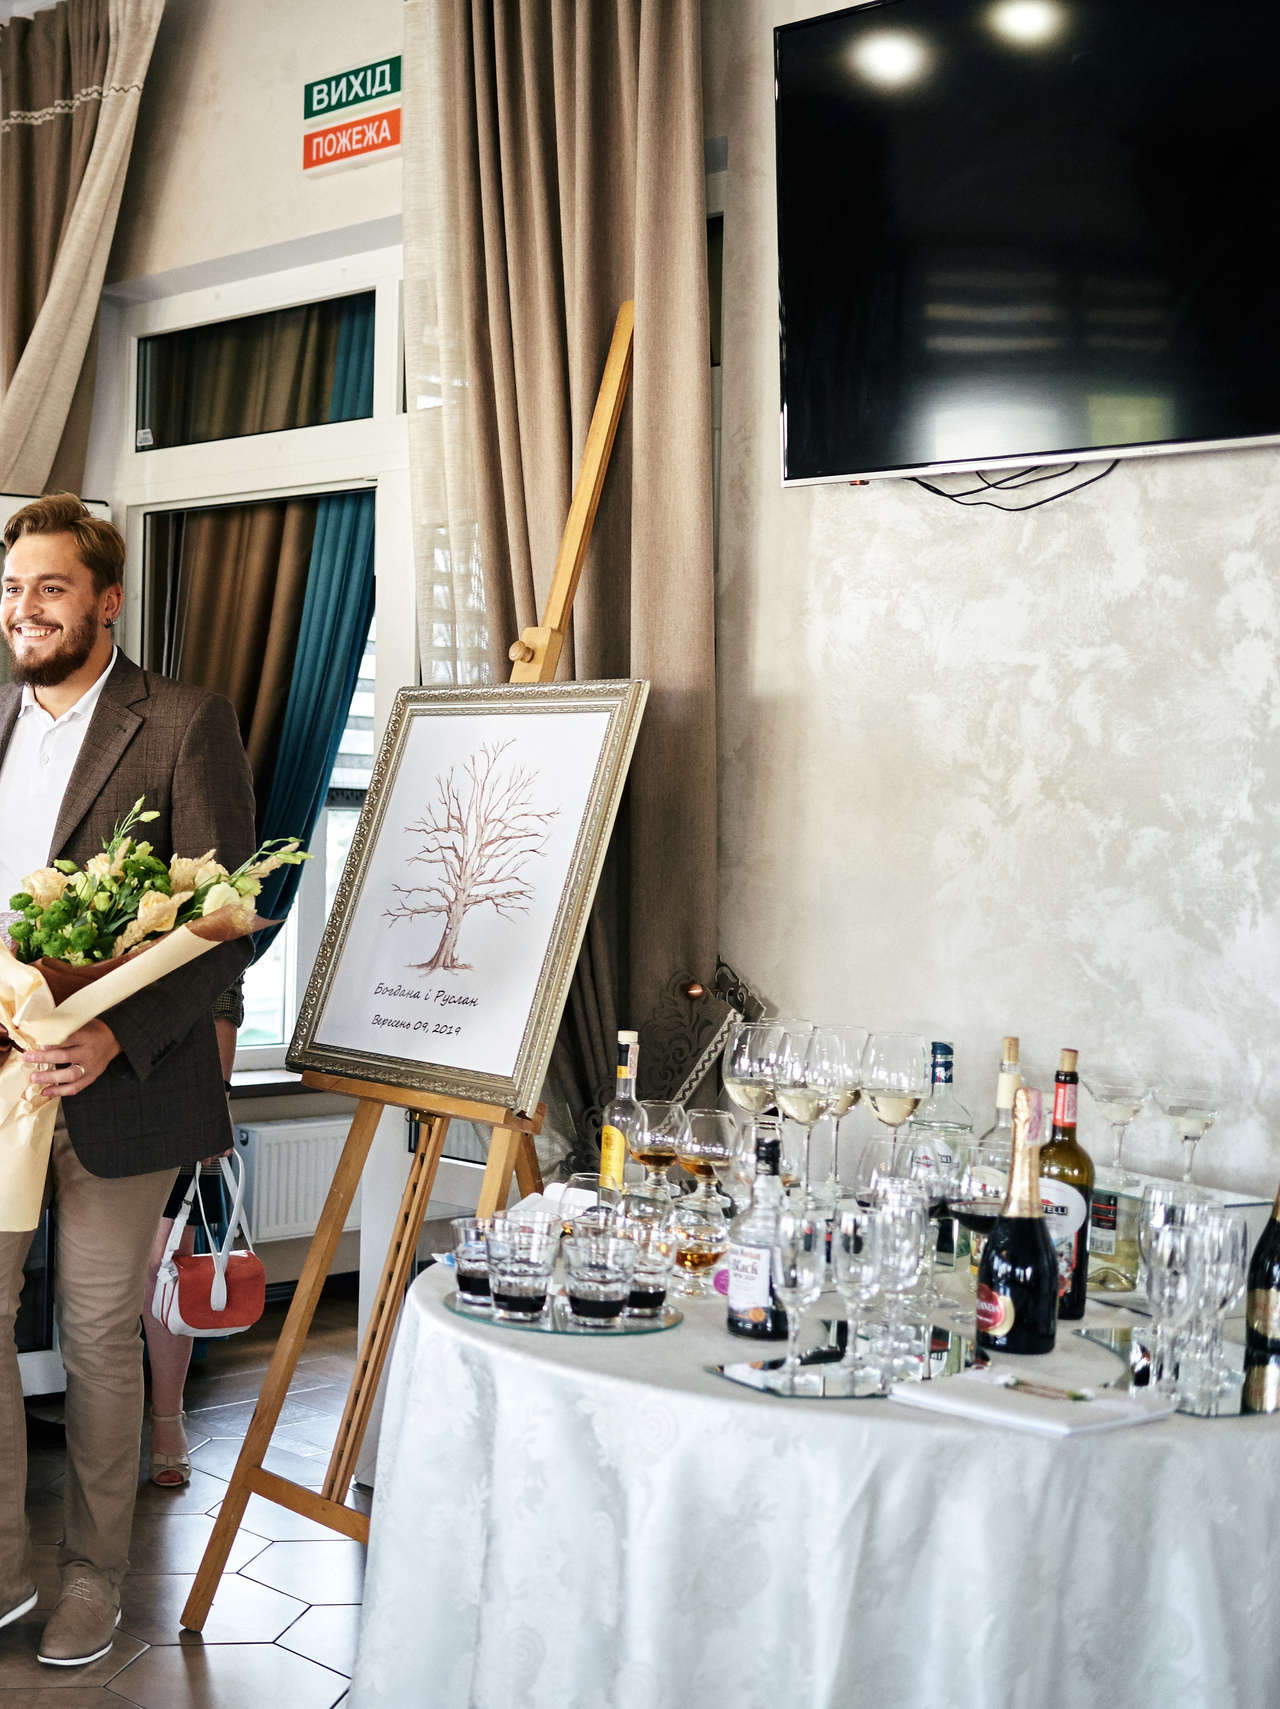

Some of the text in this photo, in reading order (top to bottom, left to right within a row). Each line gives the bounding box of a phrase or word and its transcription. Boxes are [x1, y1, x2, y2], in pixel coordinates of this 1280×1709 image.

[312, 63, 392, 112] ВИХІД
[312, 118, 392, 160] ПОЖЕЖА
[373, 982, 479, 1007] Богдана і Руслан
[371, 1014, 462, 1036] Вересень 09, 2019
[1042, 1205, 1068, 1215] TELLI
